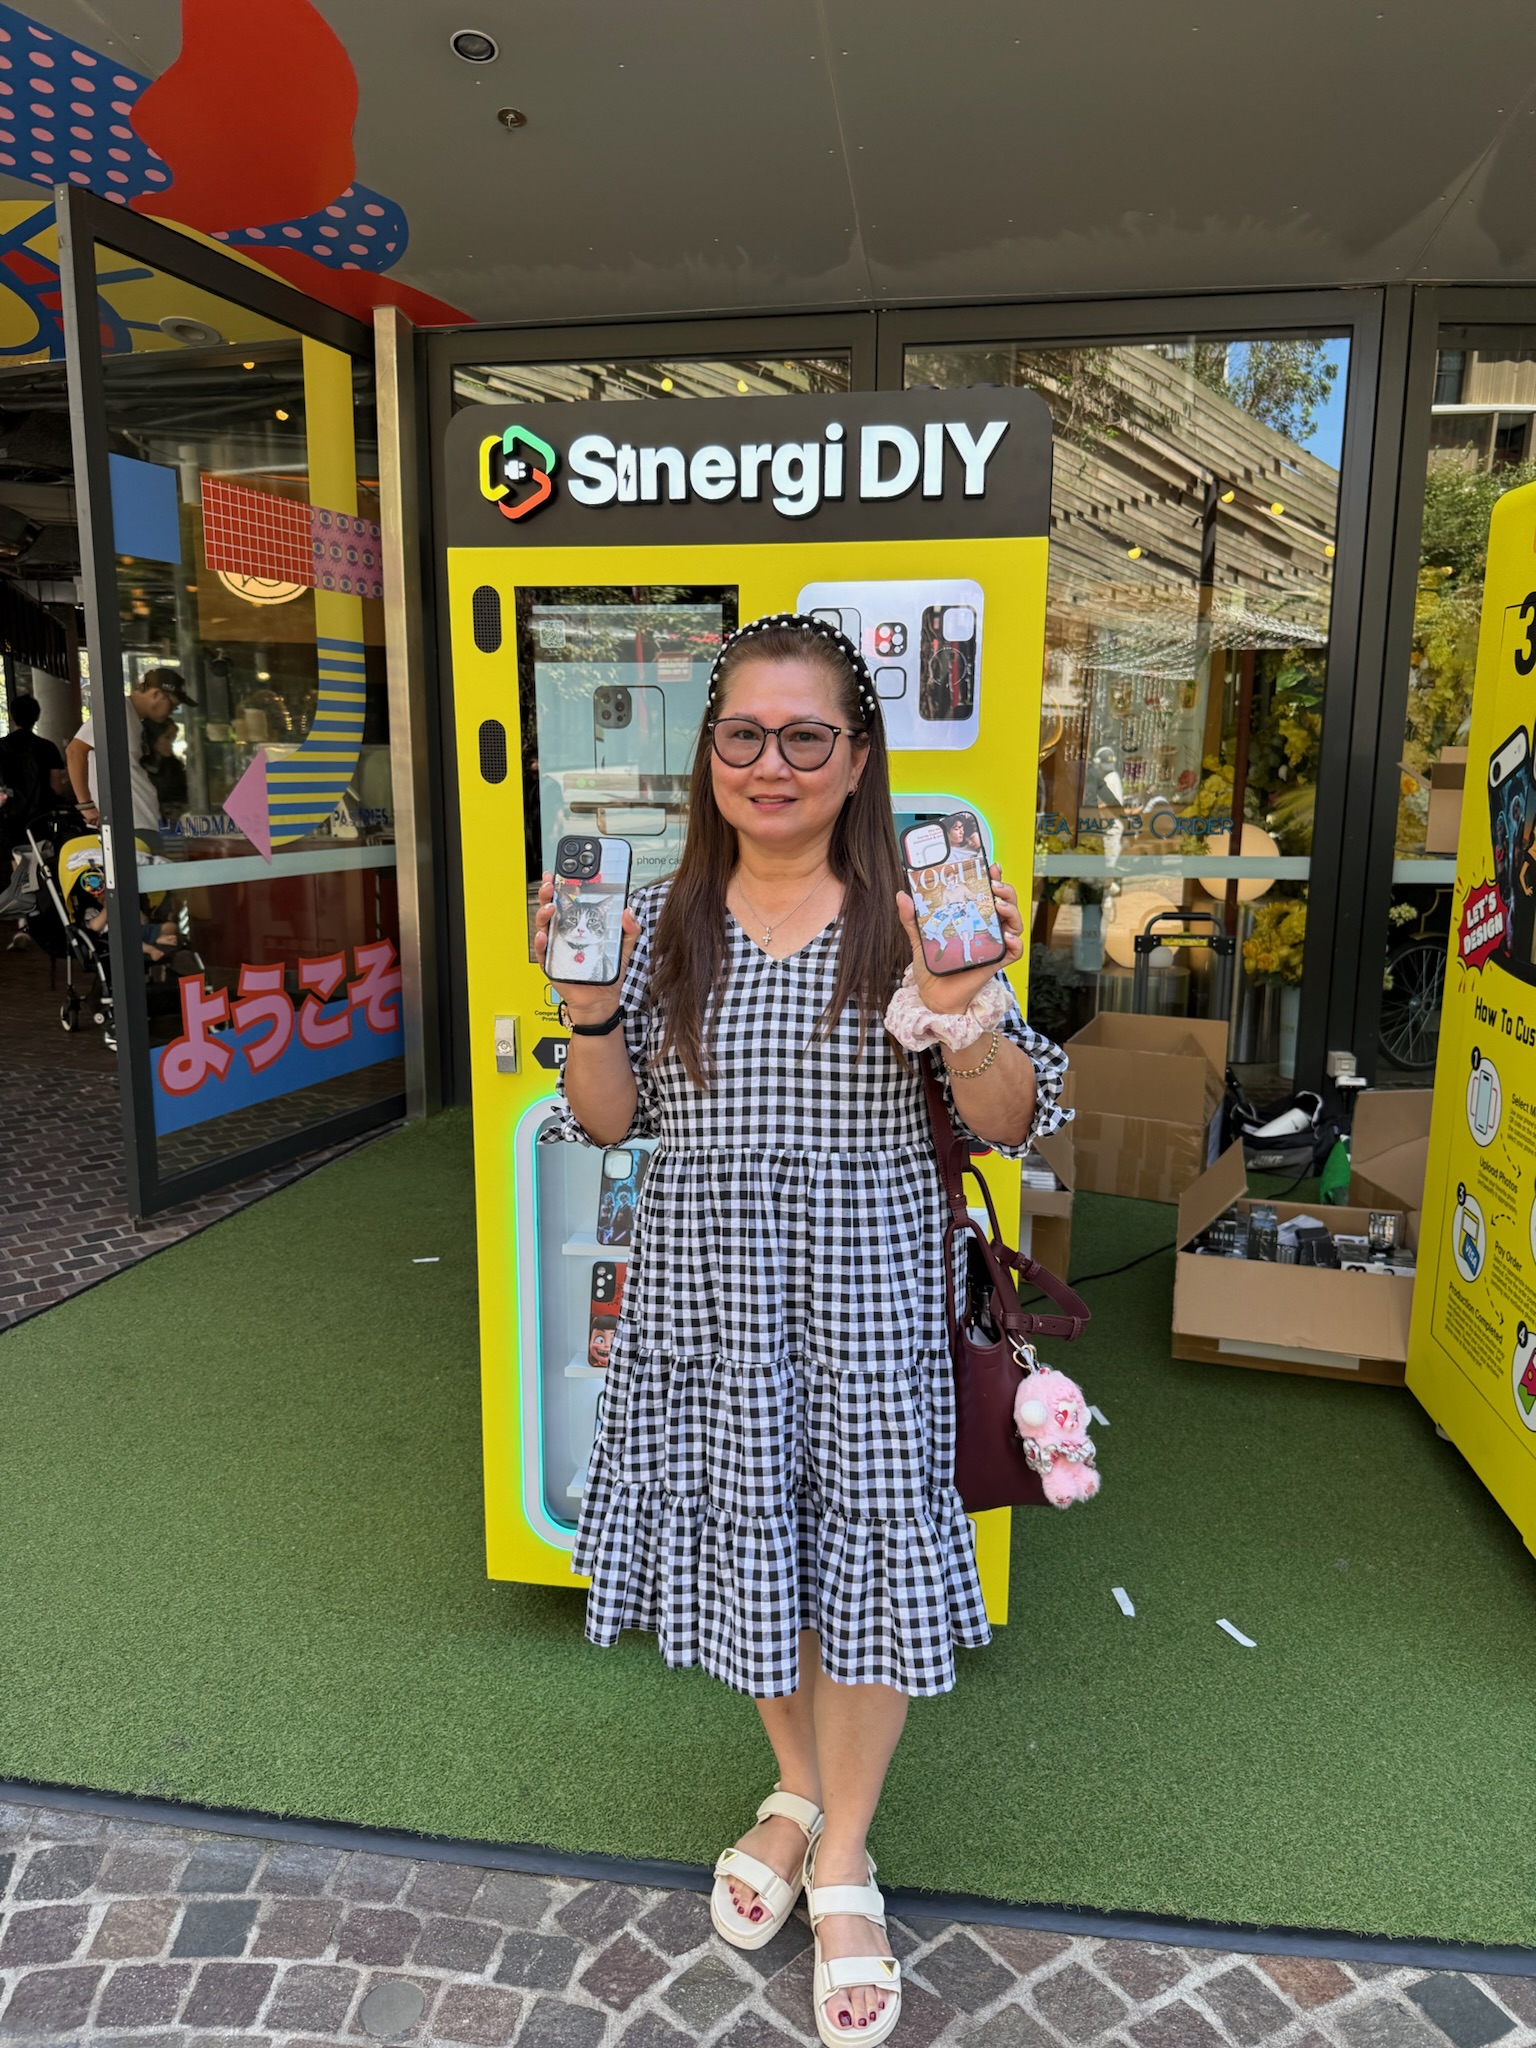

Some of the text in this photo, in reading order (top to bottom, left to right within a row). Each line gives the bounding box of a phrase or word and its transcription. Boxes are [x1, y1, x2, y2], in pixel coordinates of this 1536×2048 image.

[860, 421, 1009, 498] DIY
[1036, 811, 1072, 835] TEA
[1150, 810, 1234, 839] ORDER
[636, 855, 667, 867] phone
[1467, 890, 1497, 930] LET'S
[1463, 911, 1504, 956] DESIGN
[159, 938, 402, 1096] ようこそ
[1474, 995, 1498, 1028] How
[1501, 1007, 1513, 1036] To
[1479, 1155, 1518, 1194] Upload Photos
[1494, 1240, 1523, 1272] Pay Order
[1448, 1280, 1475, 1316] Production
[1474, 1308, 1503, 1345] Completed
